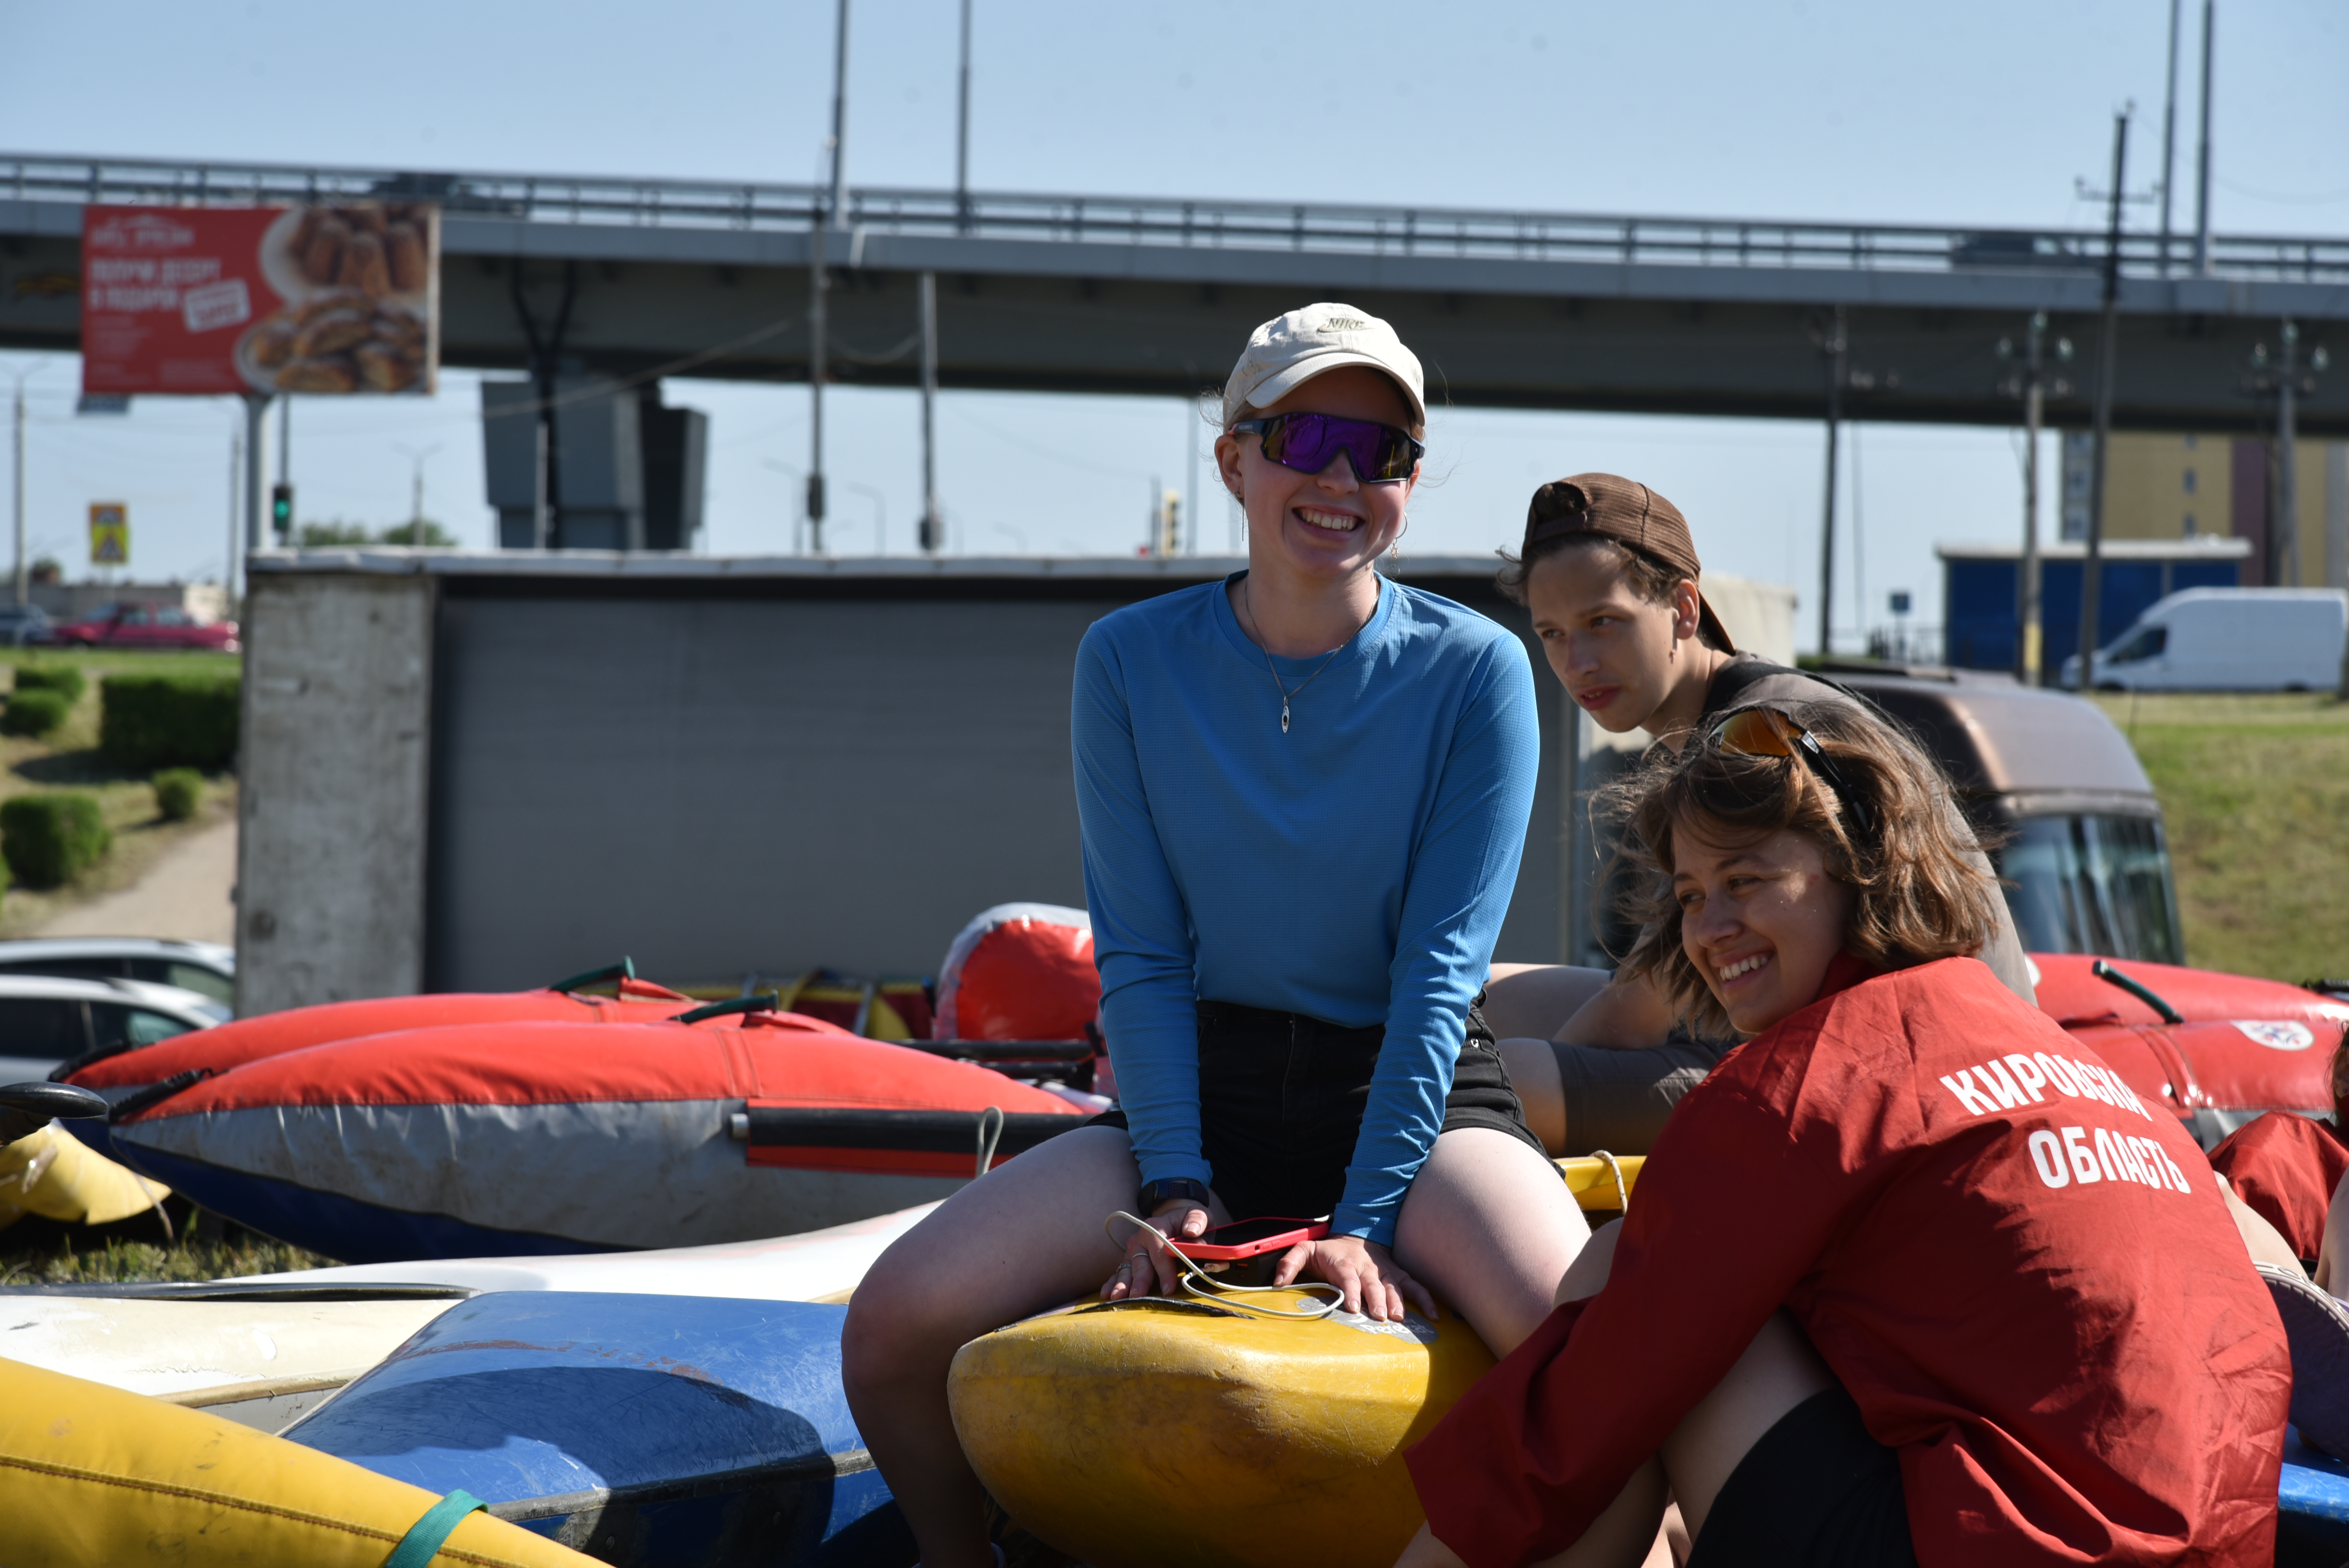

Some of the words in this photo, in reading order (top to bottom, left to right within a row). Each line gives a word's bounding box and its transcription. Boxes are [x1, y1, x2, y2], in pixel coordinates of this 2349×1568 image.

[1327, 317, 1365, 330] NIKE
[1939, 1052, 2153, 1121] КИРОВСКА
[2028, 1126, 2191, 1194] ОБЛАСТЬ
